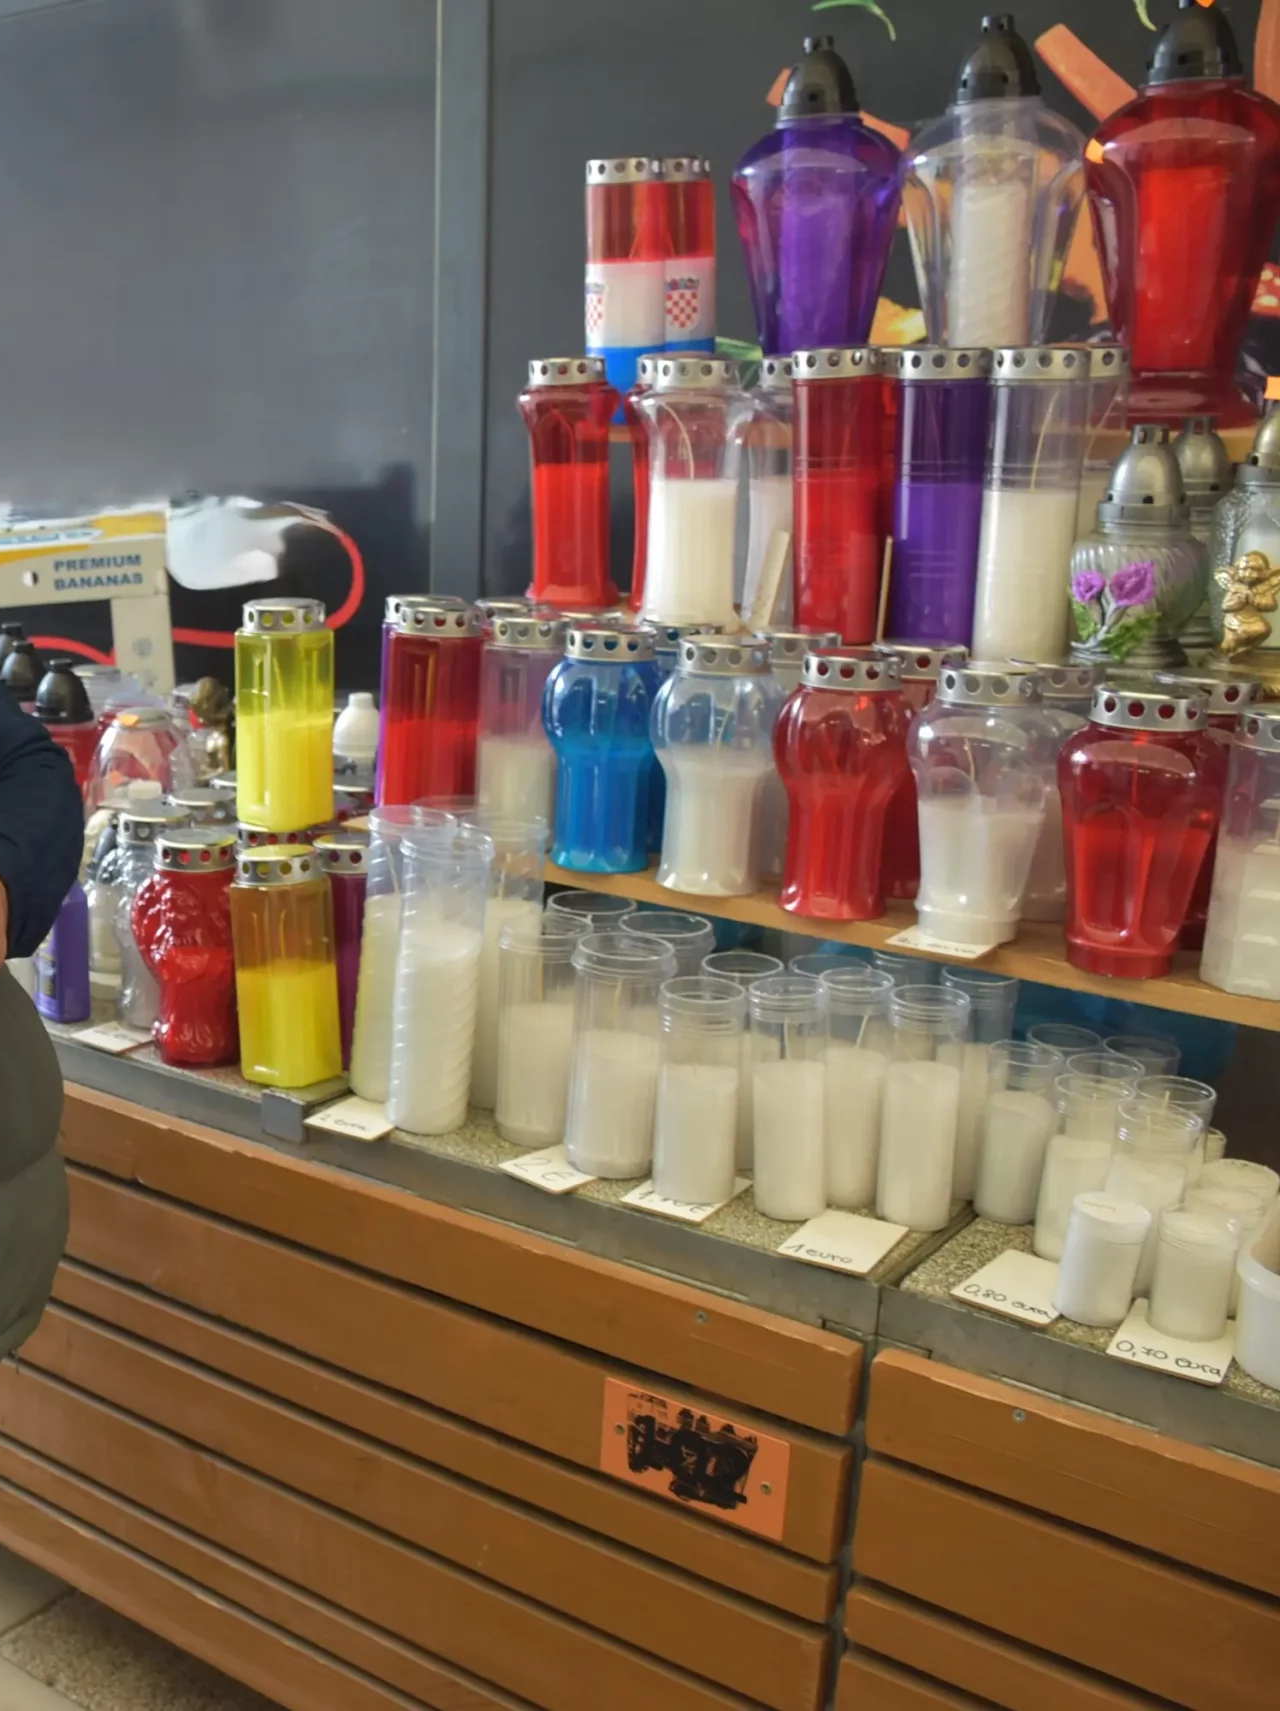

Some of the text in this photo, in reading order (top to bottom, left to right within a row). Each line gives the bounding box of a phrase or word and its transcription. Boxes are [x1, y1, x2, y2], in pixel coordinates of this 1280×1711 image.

[53, 554, 142, 572] PREMIUM
[54, 573, 144, 591] BANANAS
[513, 1157, 551, 1173] 2
[784, 1244, 853, 1264] 1 euro
[963, 1283, 1008, 1302] 0,80
